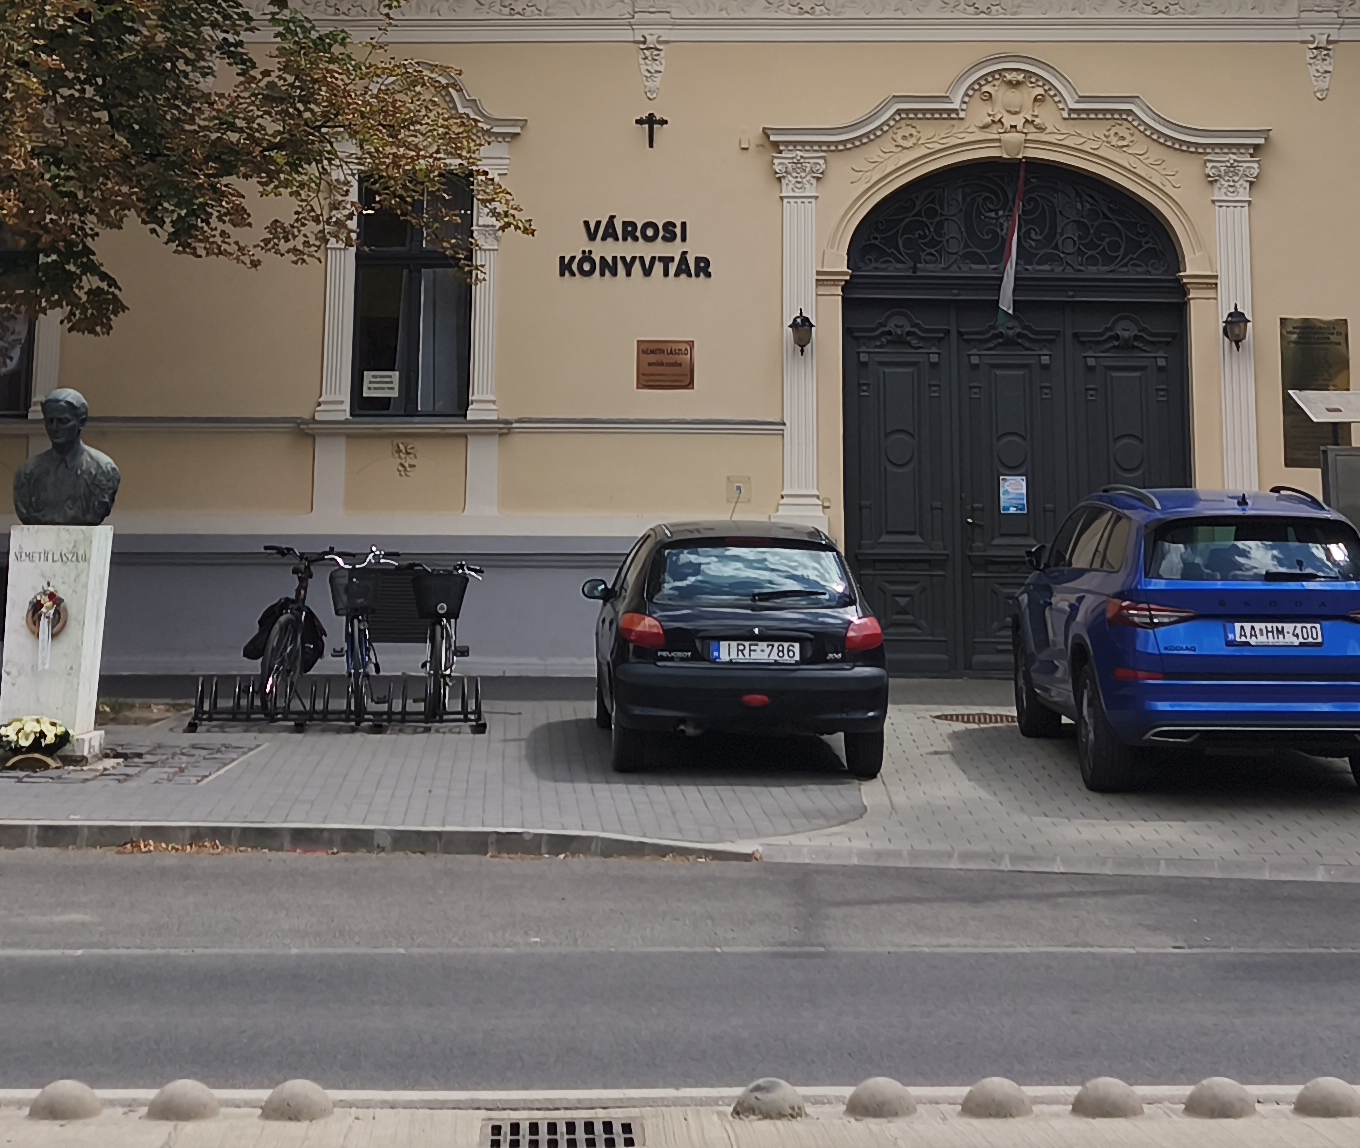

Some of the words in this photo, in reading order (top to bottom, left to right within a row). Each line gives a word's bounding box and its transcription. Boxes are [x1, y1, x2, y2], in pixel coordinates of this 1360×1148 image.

[583, 215, 687, 243] VÁROSI
[558, 249, 712, 278] KÖNYVTÁR
[727, 642, 796, 659] IRF-786
[1163, 645, 1197, 653] KODIAQ
